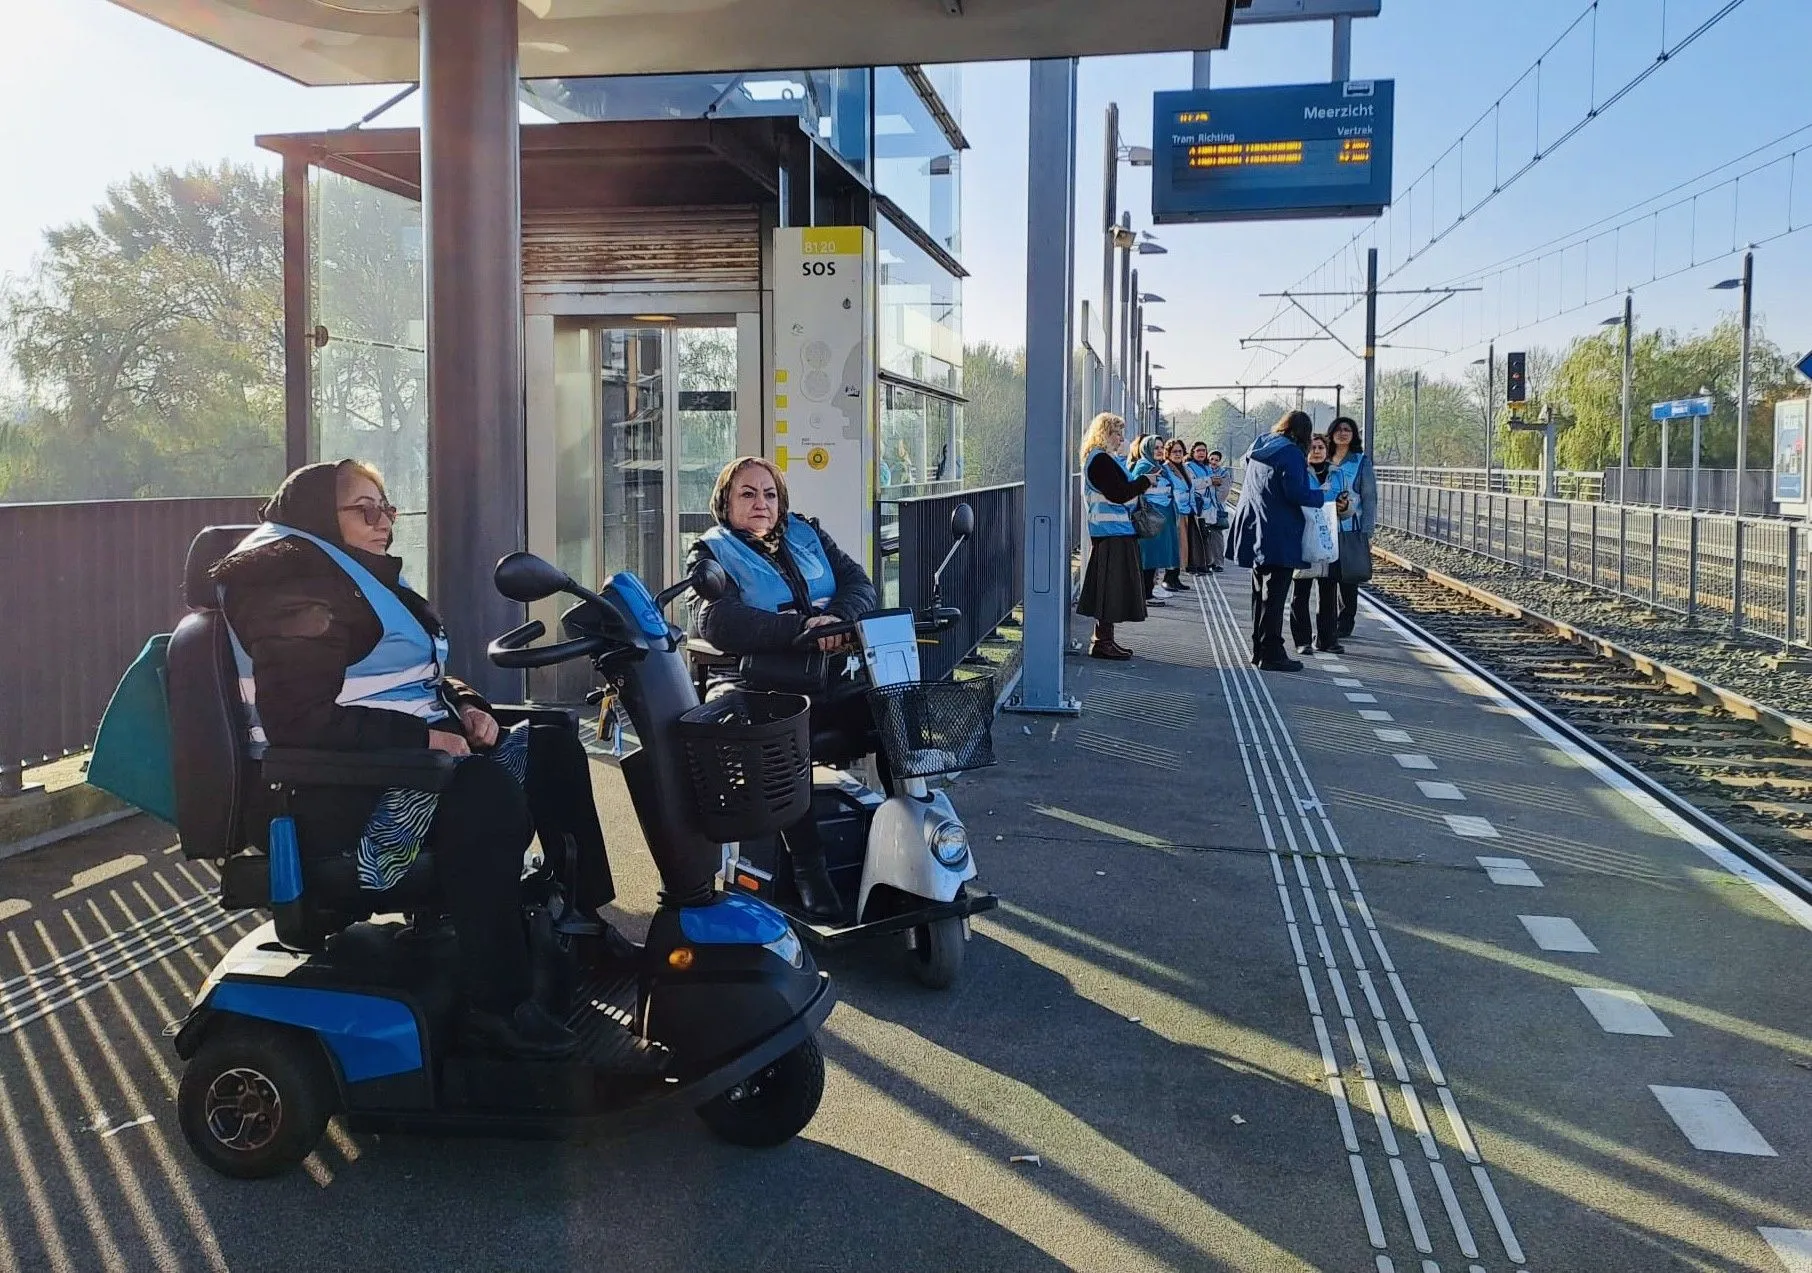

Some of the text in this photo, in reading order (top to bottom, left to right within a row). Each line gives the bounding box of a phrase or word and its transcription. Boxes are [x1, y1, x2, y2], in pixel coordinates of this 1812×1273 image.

[1304, 103, 1374, 119] Meerzicht
[1337, 125, 1373, 136] Vertrek
[1172, 132, 1235, 145] Tram Richting
[802, 262, 836, 276] SOS
